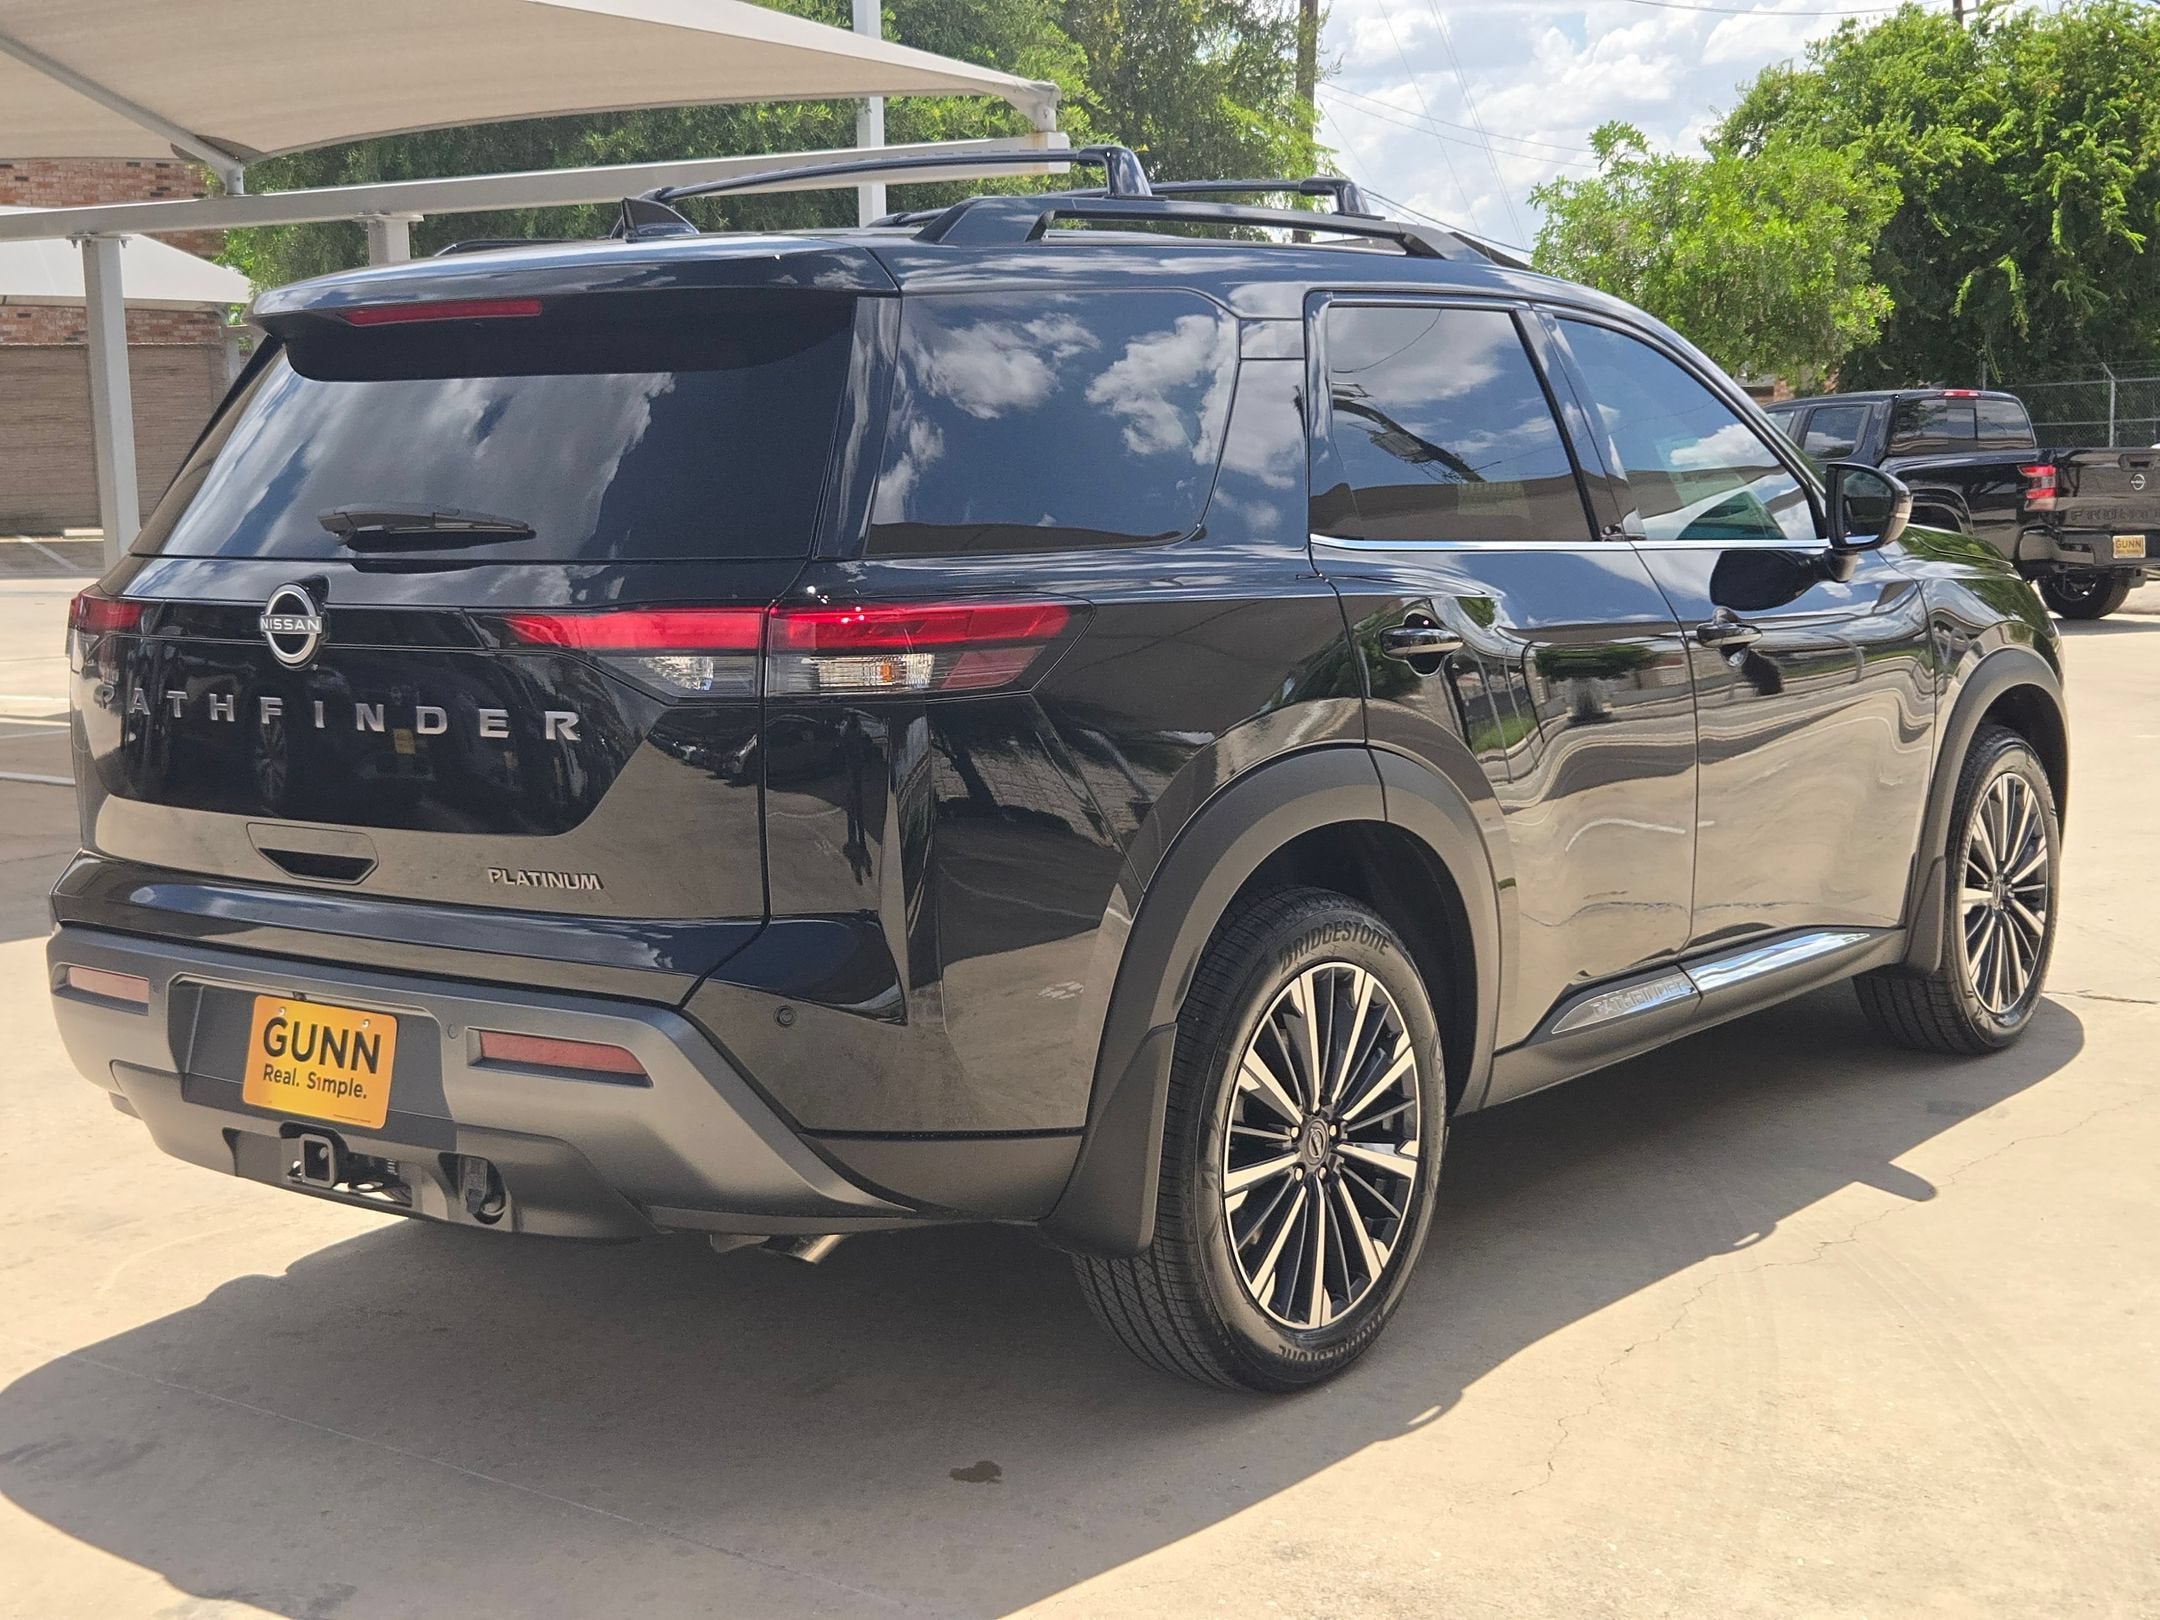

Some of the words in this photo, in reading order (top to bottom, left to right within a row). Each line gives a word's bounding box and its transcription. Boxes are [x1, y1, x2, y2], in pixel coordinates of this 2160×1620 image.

[260, 616, 322, 632] NISSAN
[96, 685, 582, 742] PATHFINDER
[487, 867, 604, 890] PLATINUM
[1280, 920, 1389, 975] BRIDGESTONE
[263, 1016, 382, 1074] GUNN
[262, 1063, 300, 1088] Real.
